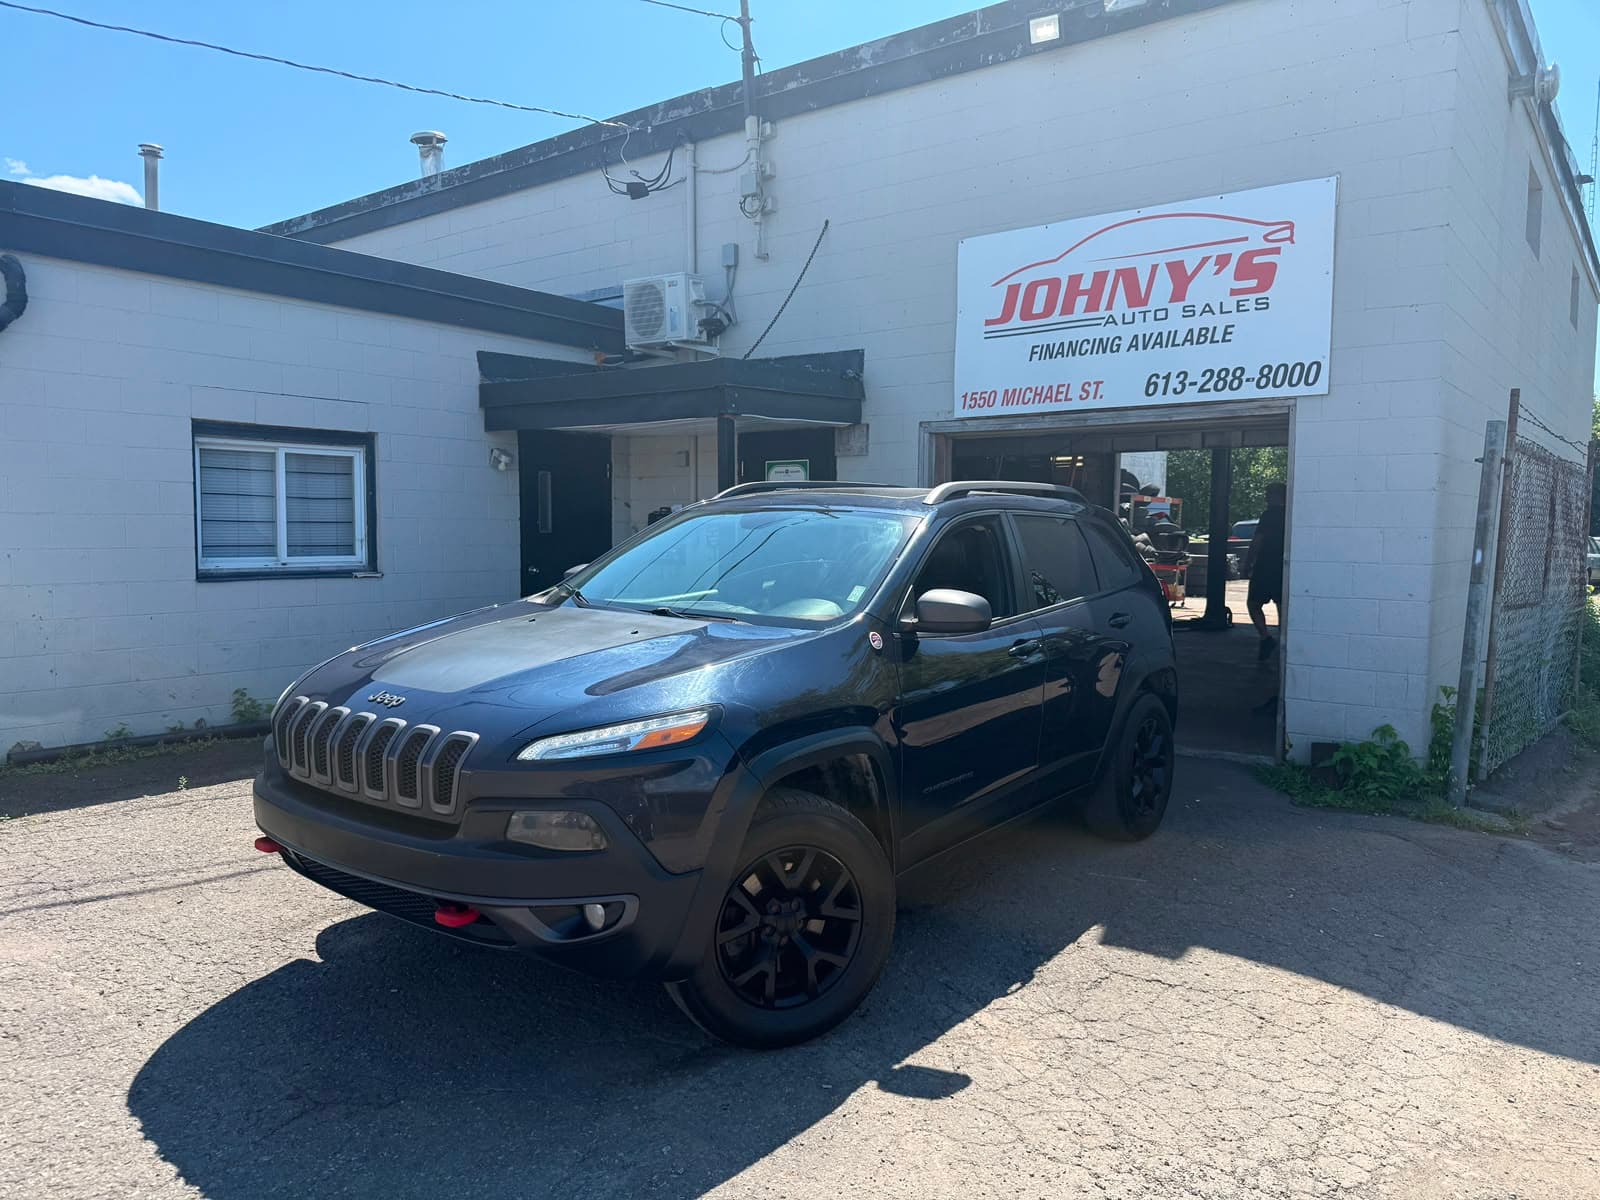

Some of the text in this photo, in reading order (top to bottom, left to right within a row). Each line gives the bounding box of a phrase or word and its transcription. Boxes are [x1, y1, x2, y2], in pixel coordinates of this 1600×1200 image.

[984, 247, 1282, 326] JOHNY'S
[1103, 297, 1270, 328] AUTO SALES
[1029, 324, 1236, 362] FINANCING AVAILABLE
[960, 381, 1105, 410] 1550 MICHAEL ST.
[1144, 361, 1322, 397] 613-288-8000
[368, 690, 406, 709] Jeep
